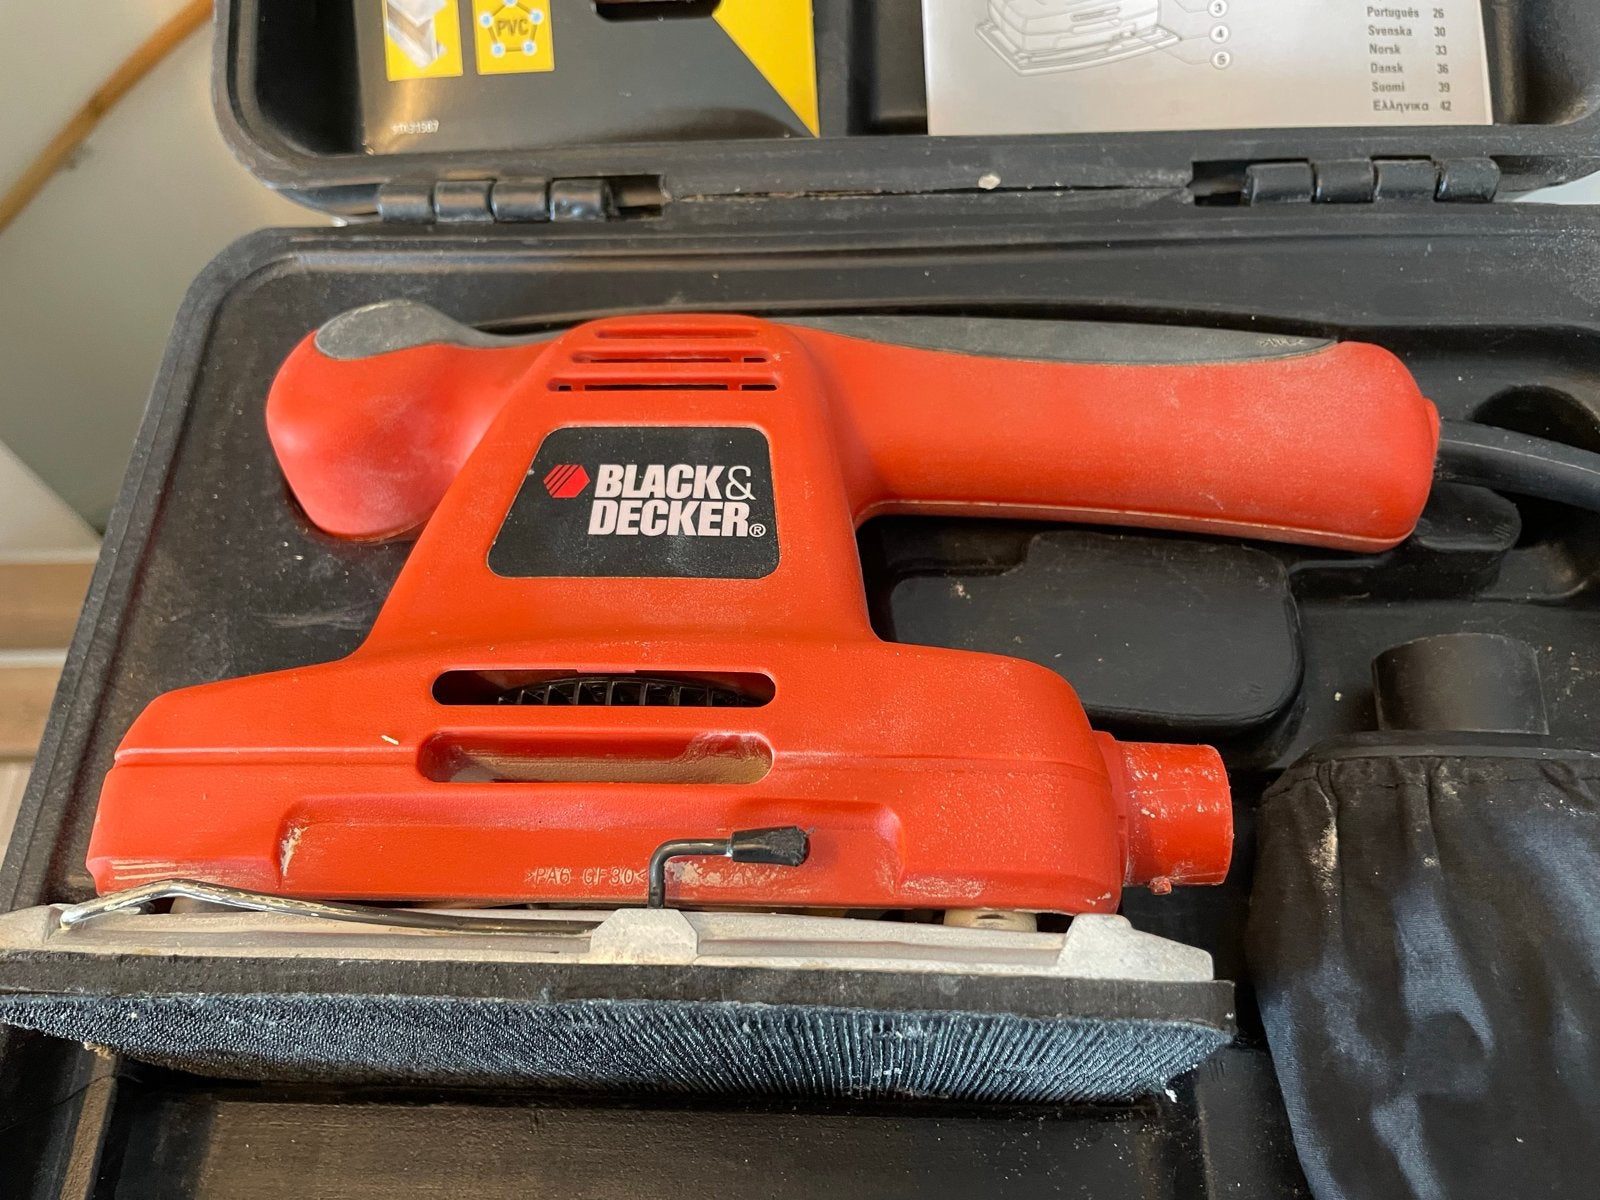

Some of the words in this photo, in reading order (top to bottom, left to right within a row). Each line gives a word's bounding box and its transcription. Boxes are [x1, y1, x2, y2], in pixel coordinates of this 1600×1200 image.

[1366, 6, 1420, 20] Português
[1433, 8, 1445, 19] 26
[496, 18, 530, 37] PVC
[1368, 25, 1413, 37] Svenska
[1434, 26, 1446, 37] 30
[1369, 43, 1401, 54] Norsk
[1435, 45, 1447, 56] 33
[1370, 62, 1403, 73] Dansk
[1437, 63, 1449, 74] 36
[1372, 81, 1405, 92] Suomi
[1438, 82, 1450, 93] 39
[1440, 100, 1452, 111] 42
